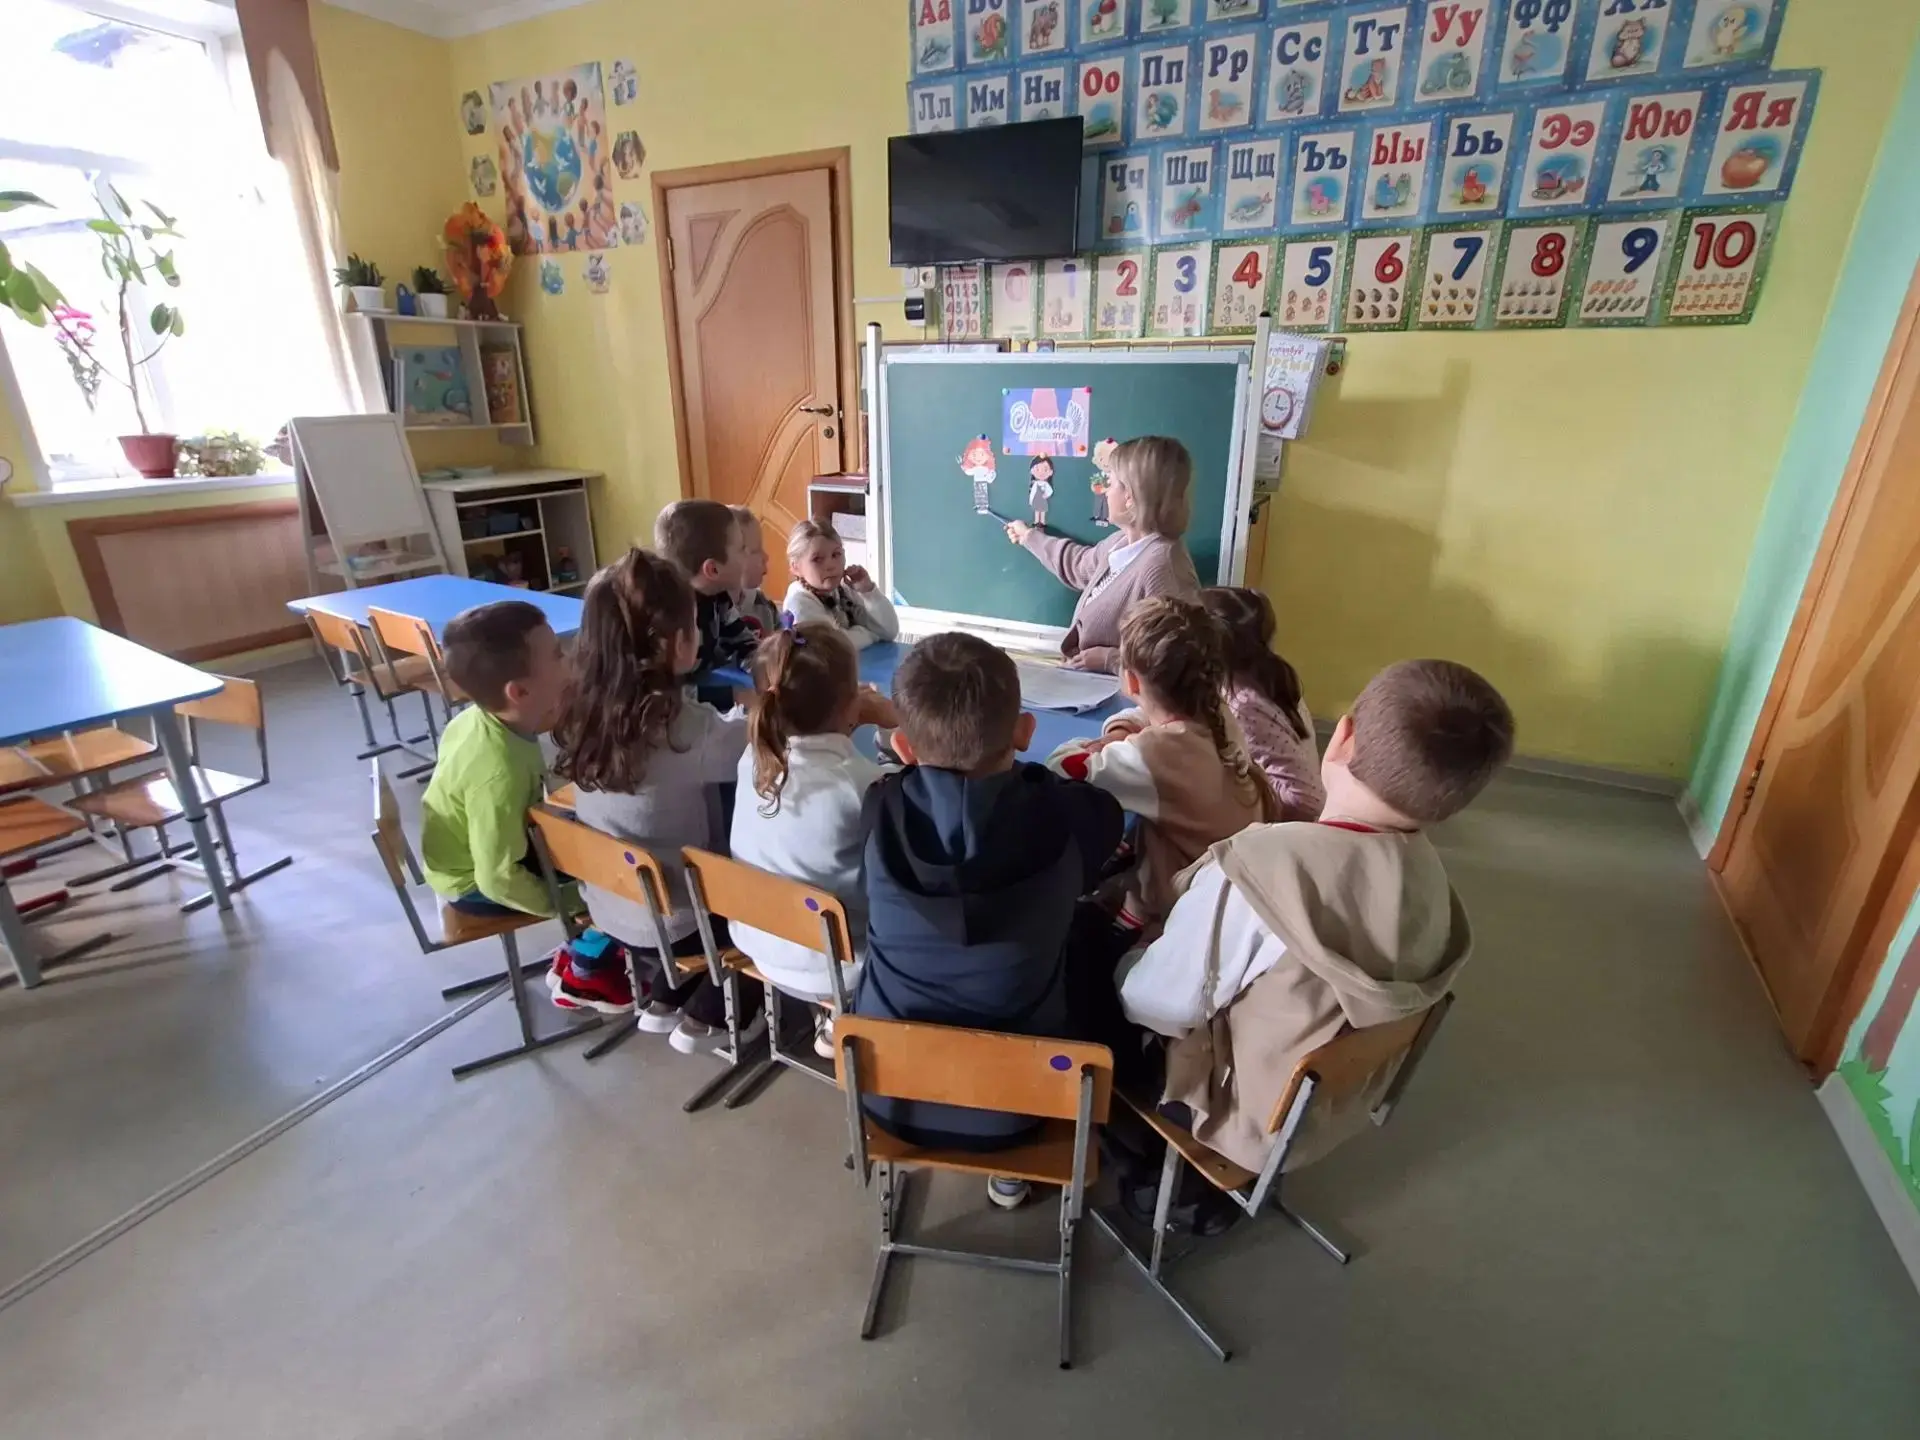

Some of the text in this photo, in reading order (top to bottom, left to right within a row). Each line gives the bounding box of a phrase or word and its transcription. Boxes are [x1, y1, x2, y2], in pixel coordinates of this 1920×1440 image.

[918, 0, 950, 26] Аа
[918, 92, 951, 120] Лл
[970, 84, 1005, 114] Мм
[1024, 75, 1061, 105] Нн
[1083, 67, 1121, 97] Оо
[1142, 56, 1184, 87] Пп
[1209, 44, 1248, 82] Рр
[1277, 31, 1322, 65] Сс
[1353, 18, 1400, 54] Тт
[1430, 2, 1482, 46] Уу
[1514, 0, 1571, 33] Фф
[1110, 91, 1797, 193] Чч Шш Щщ Ъъ Ыы Ьь Ээ Юю Яя
[1116, 260, 1137, 296] 2
[1174, 256, 1197, 293] 3
[1232, 251, 1262, 289] 4
[1304, 246, 1334, 287] 5
[1375, 242, 1403, 284] 6
[1453, 236, 1484, 281] 7
[1531, 232, 1567, 277] 8
[1621, 227, 1659, 274] 9
[1693, 219, 1756, 271] 10
